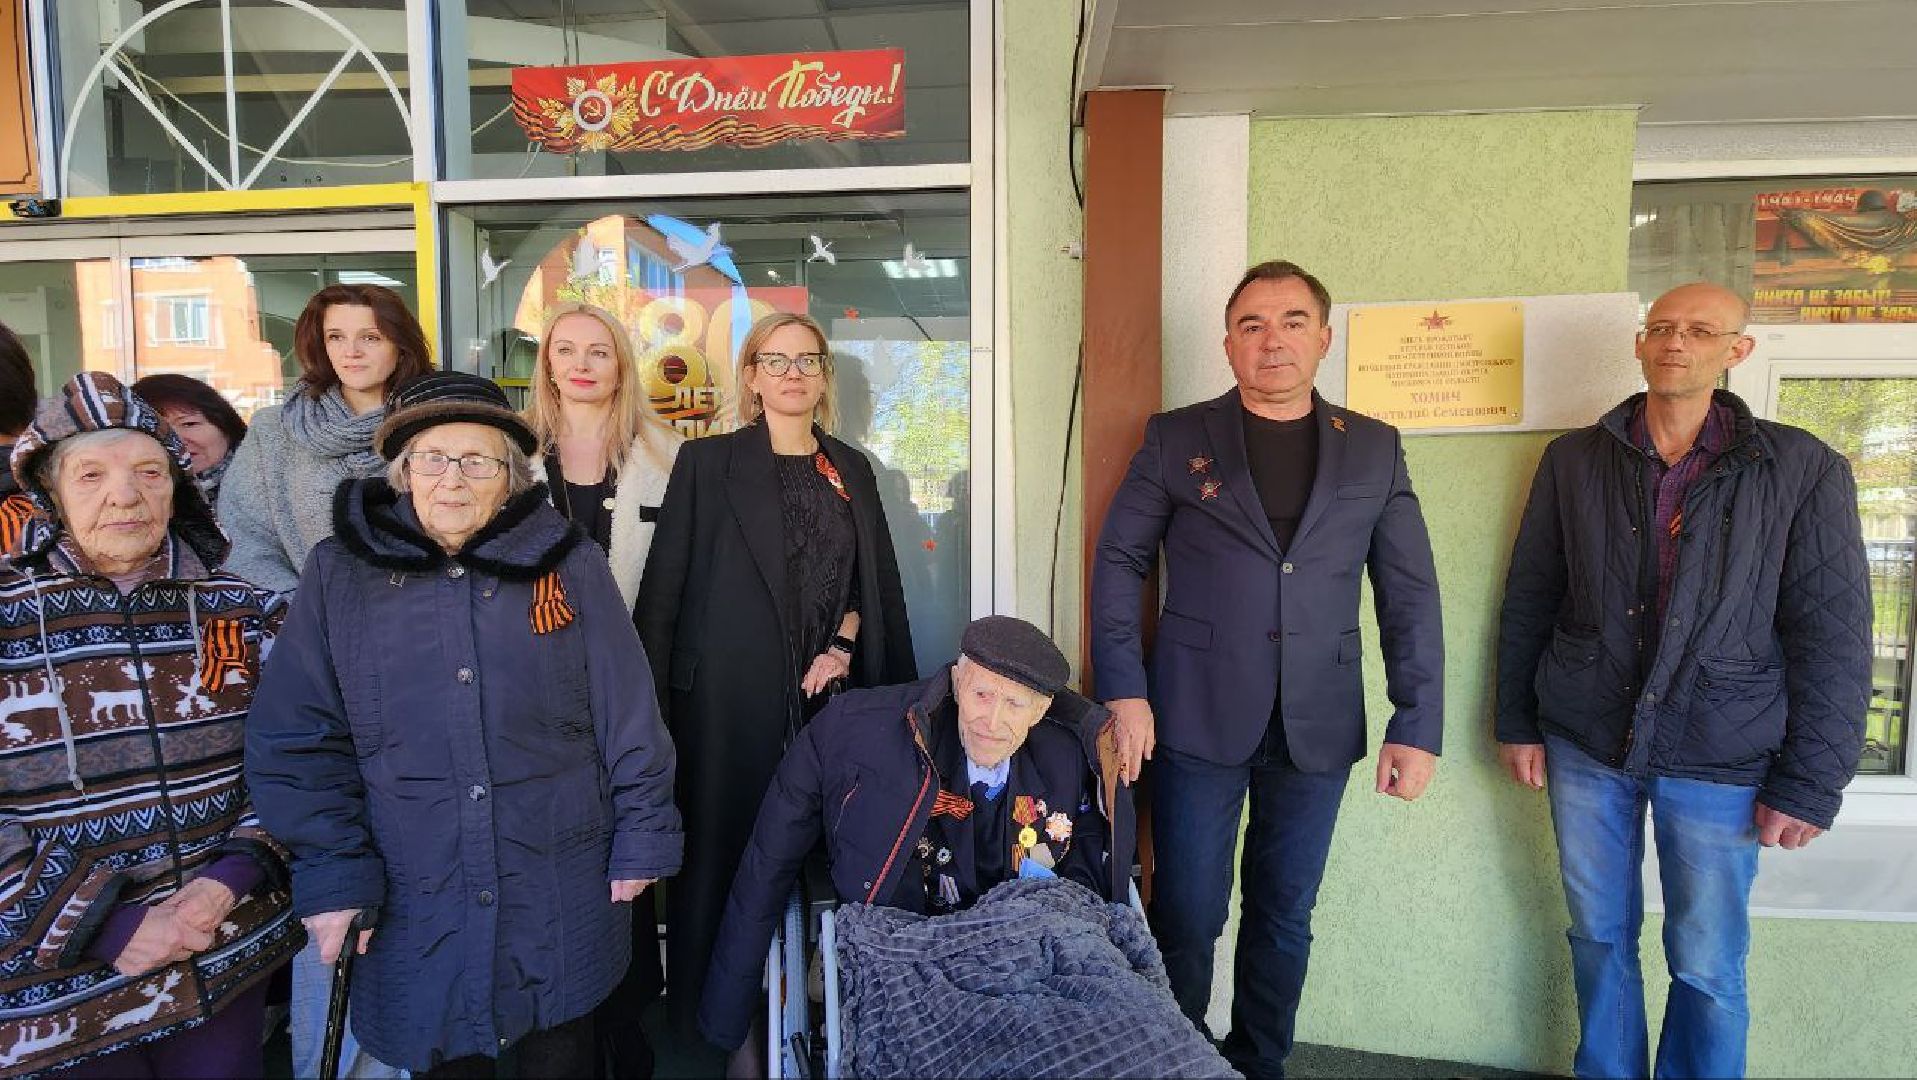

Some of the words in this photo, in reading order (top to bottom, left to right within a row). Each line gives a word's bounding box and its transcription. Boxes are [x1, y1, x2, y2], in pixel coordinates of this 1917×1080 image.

[640, 70, 673, 117] С
[670, 72, 768, 113] Днём
[768, 60, 901, 128] Победы!
[1754, 289, 1804, 305] НИКТО
[1809, 289, 1829, 305] НЕ
[1801, 306, 1850, 323] НИЧТО
[1856, 306, 1877, 322] НЕ
